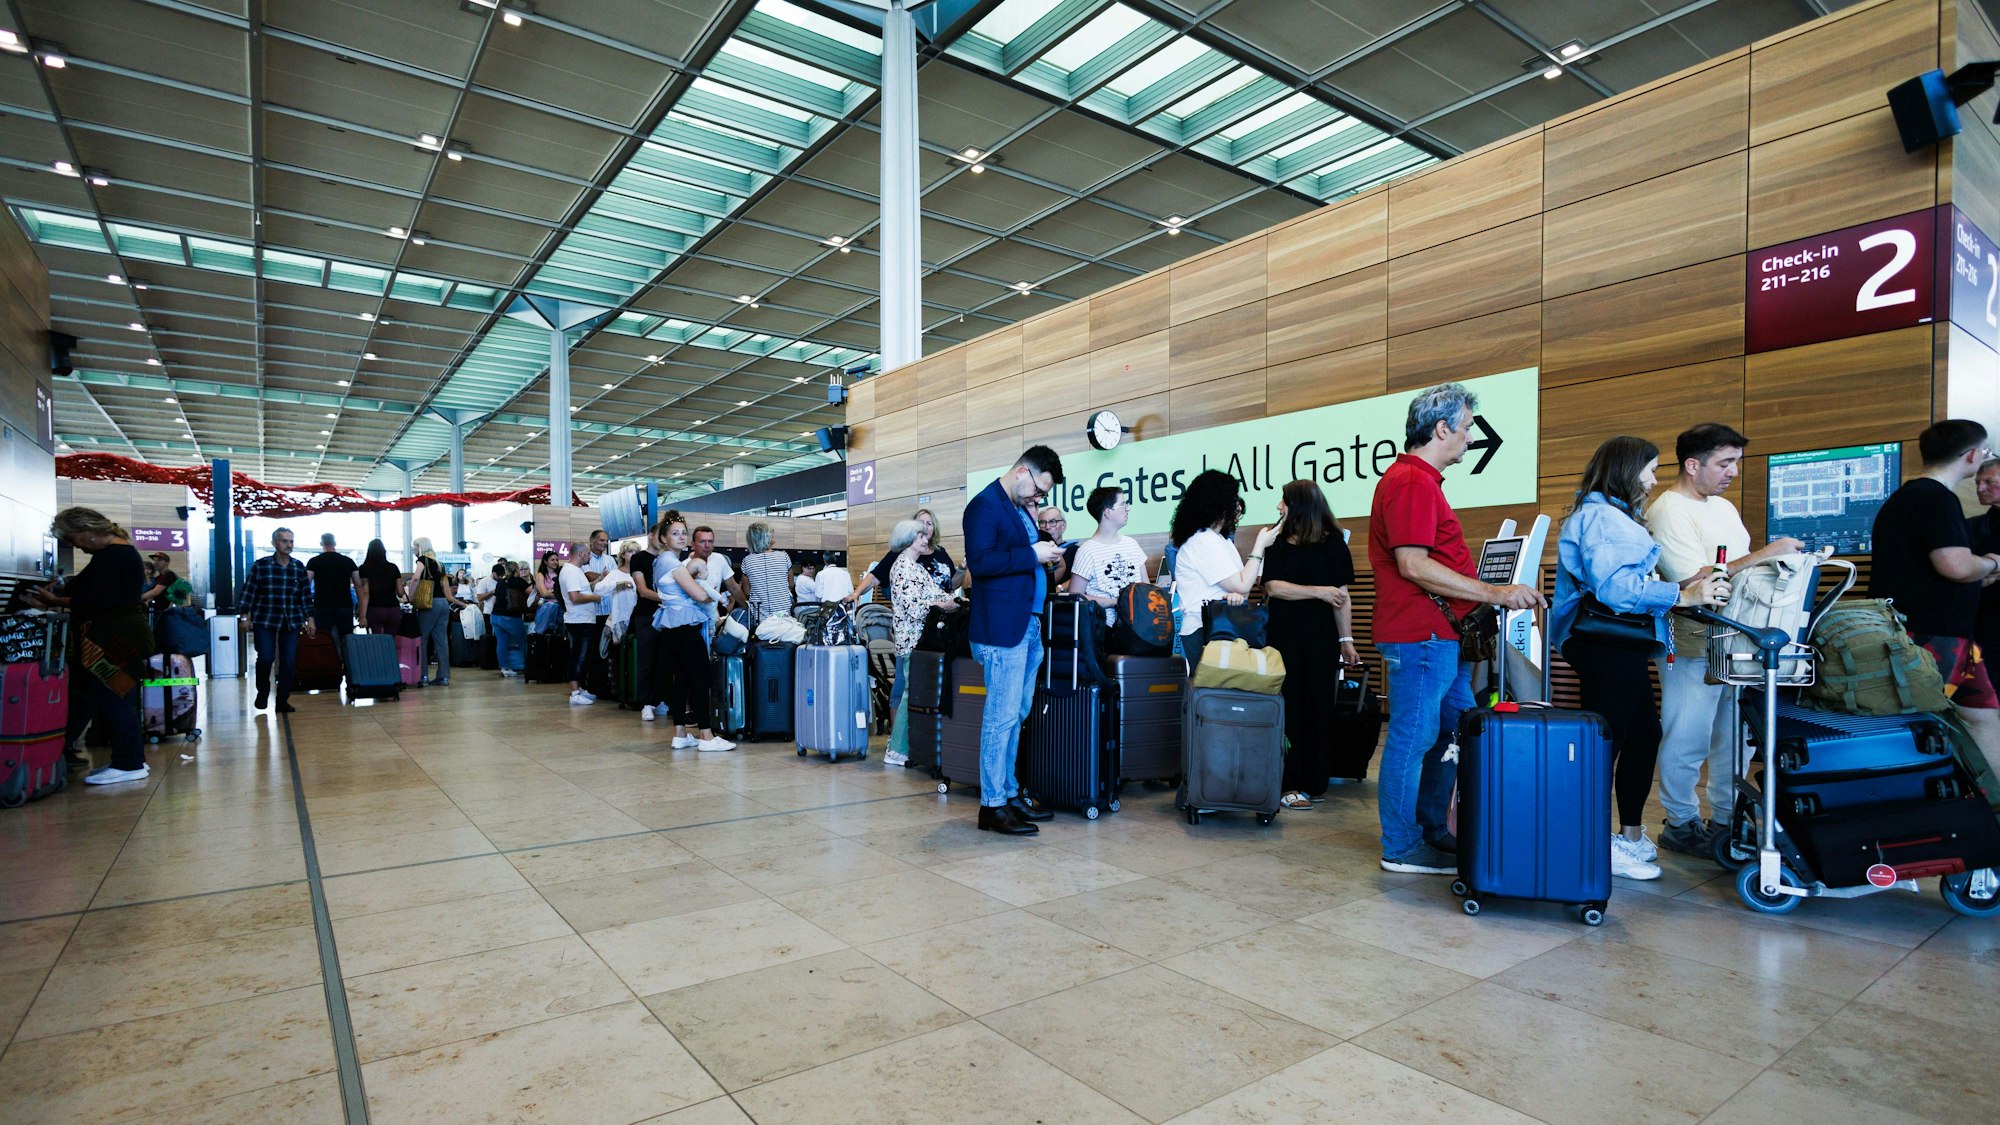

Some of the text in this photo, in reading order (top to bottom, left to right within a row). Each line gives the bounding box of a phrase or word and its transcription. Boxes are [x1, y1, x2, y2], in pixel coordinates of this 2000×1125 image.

[1957, 223, 1981, 260] Check-in
[1761, 245, 1839, 273] Check-in
[1855, 229, 1917, 312] 2
[1760, 264, 1831, 291] 211–216
[1986, 252, 1998, 328] 2
[1884, 443, 1898, 453] E1
[1227, 444, 1274, 492] All
[1291, 434, 1397, 484] Gate
[864, 466, 873, 495] 2
[170, 530, 185, 548] 3
[559, 543, 570, 557] 4
[1515, 621, 1525, 654] ck-in
